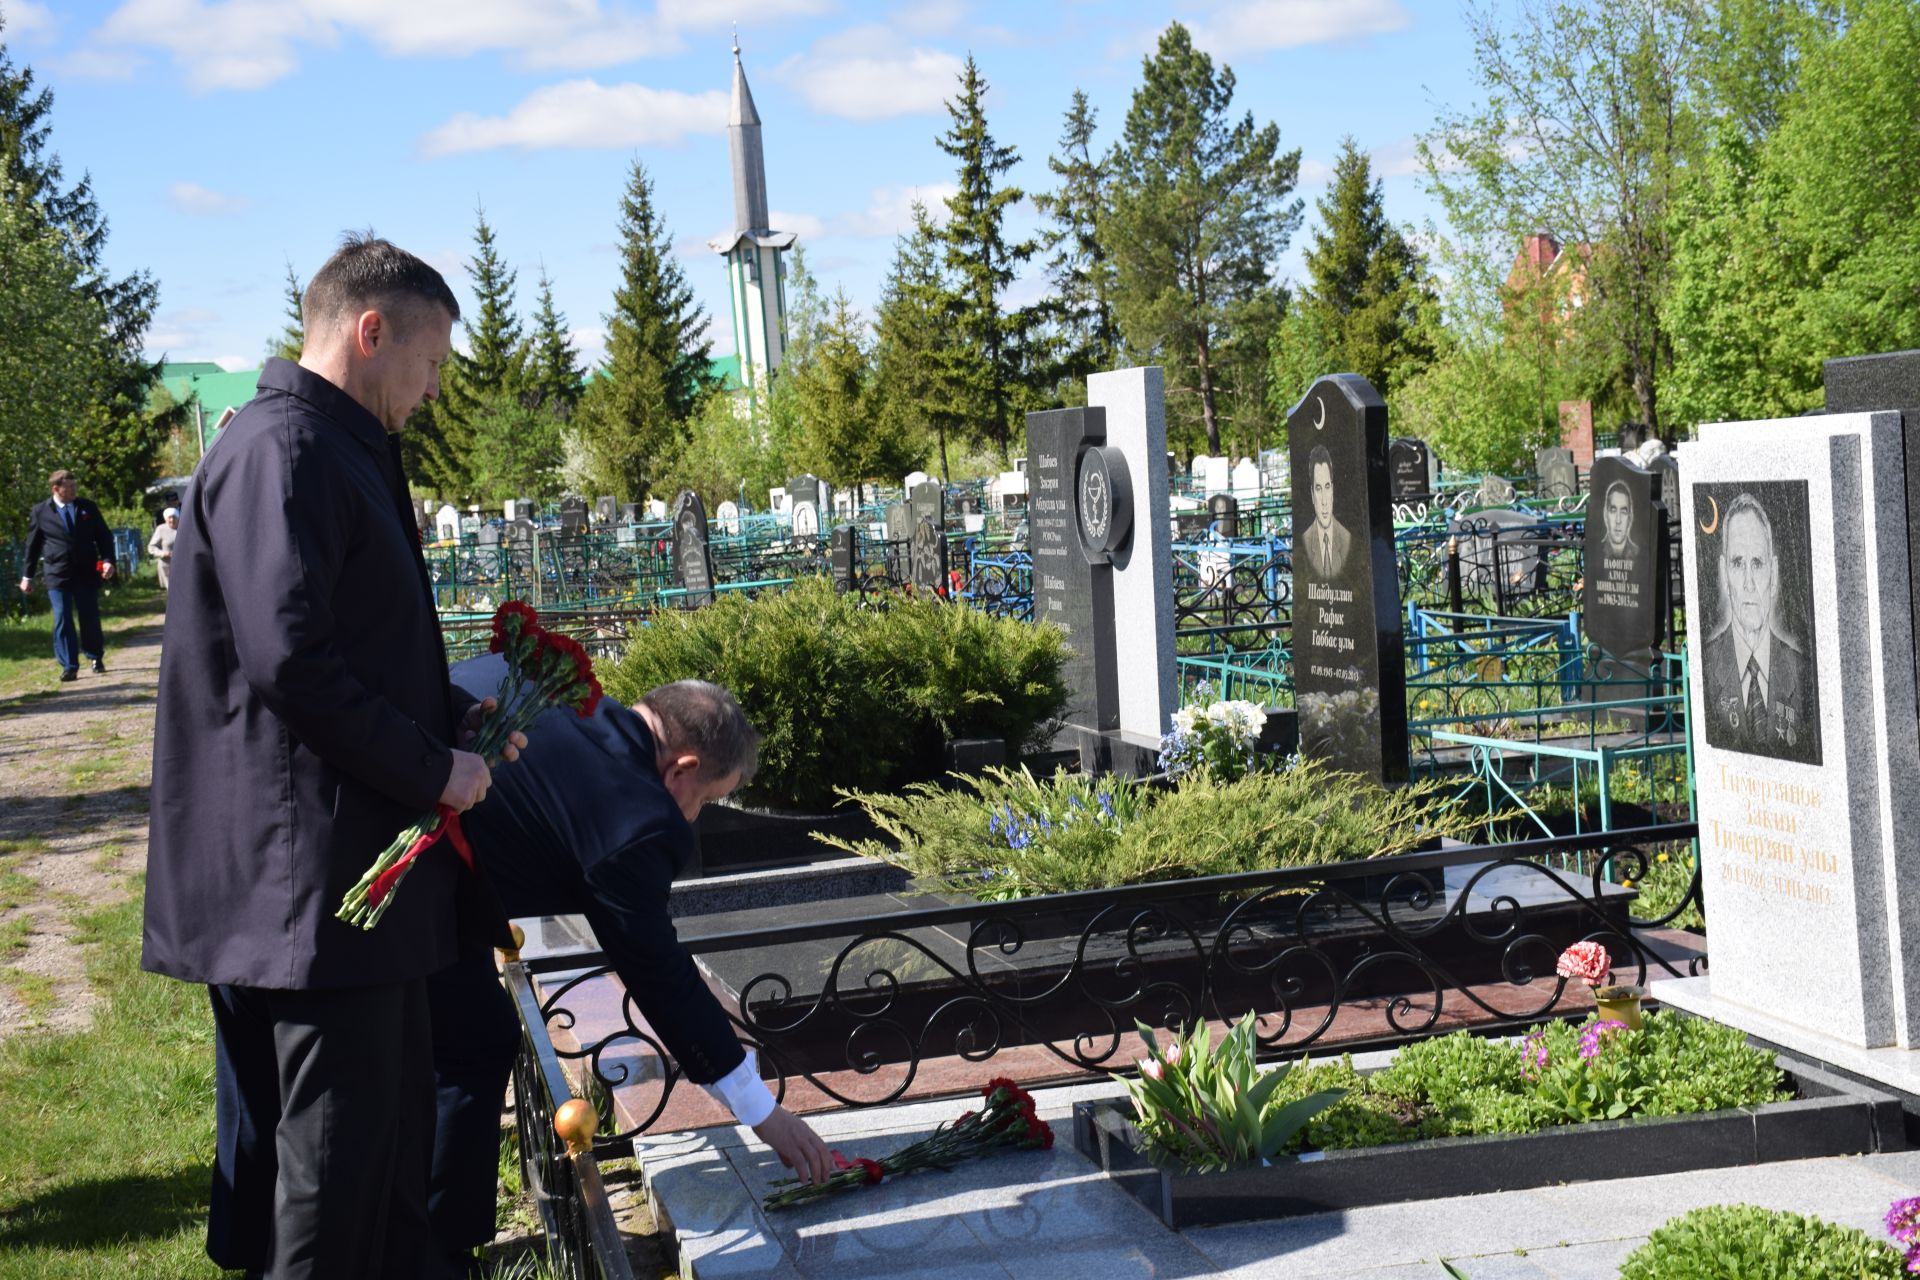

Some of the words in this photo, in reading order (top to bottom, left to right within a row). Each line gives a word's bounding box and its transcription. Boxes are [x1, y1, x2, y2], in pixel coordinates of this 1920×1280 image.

[1308, 582, 1353, 605] Шайдуллин
[1311, 629, 1337, 648] Габбас
[1338, 636, 1355, 653] улы
[1718, 763, 1820, 807] Тимерзянов
[1710, 818, 1794, 865] Тимерзян
[1800, 847, 1838, 876] улы
